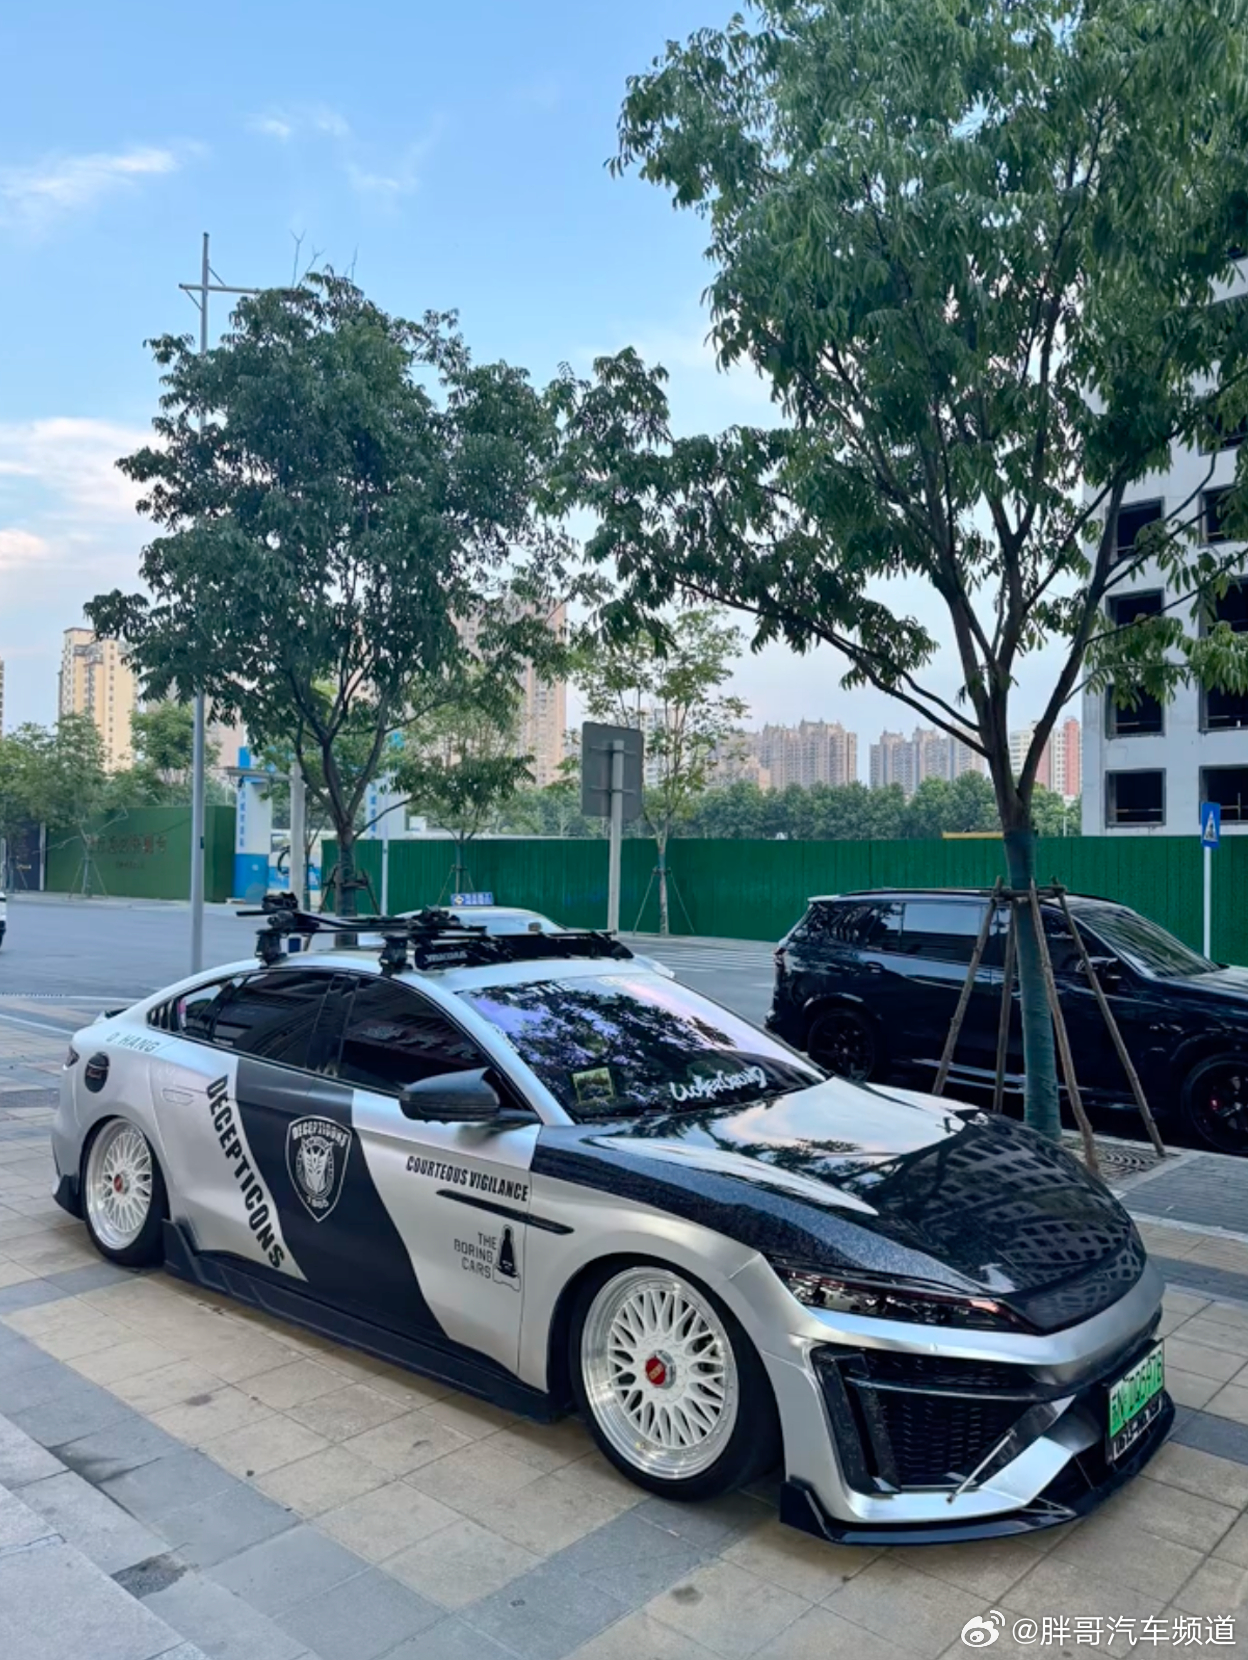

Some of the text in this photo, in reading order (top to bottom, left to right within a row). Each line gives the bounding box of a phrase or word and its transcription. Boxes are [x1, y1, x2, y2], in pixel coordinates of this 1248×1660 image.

[206, 1074, 285, 1268] DECEPTICONS
[406, 1156, 528, 1202] COURTEOUS VIGILANCE
[454, 1238, 493, 1264] BORING
[478, 1232, 497, 1250] THE
[462, 1257, 491, 1279] CARS
